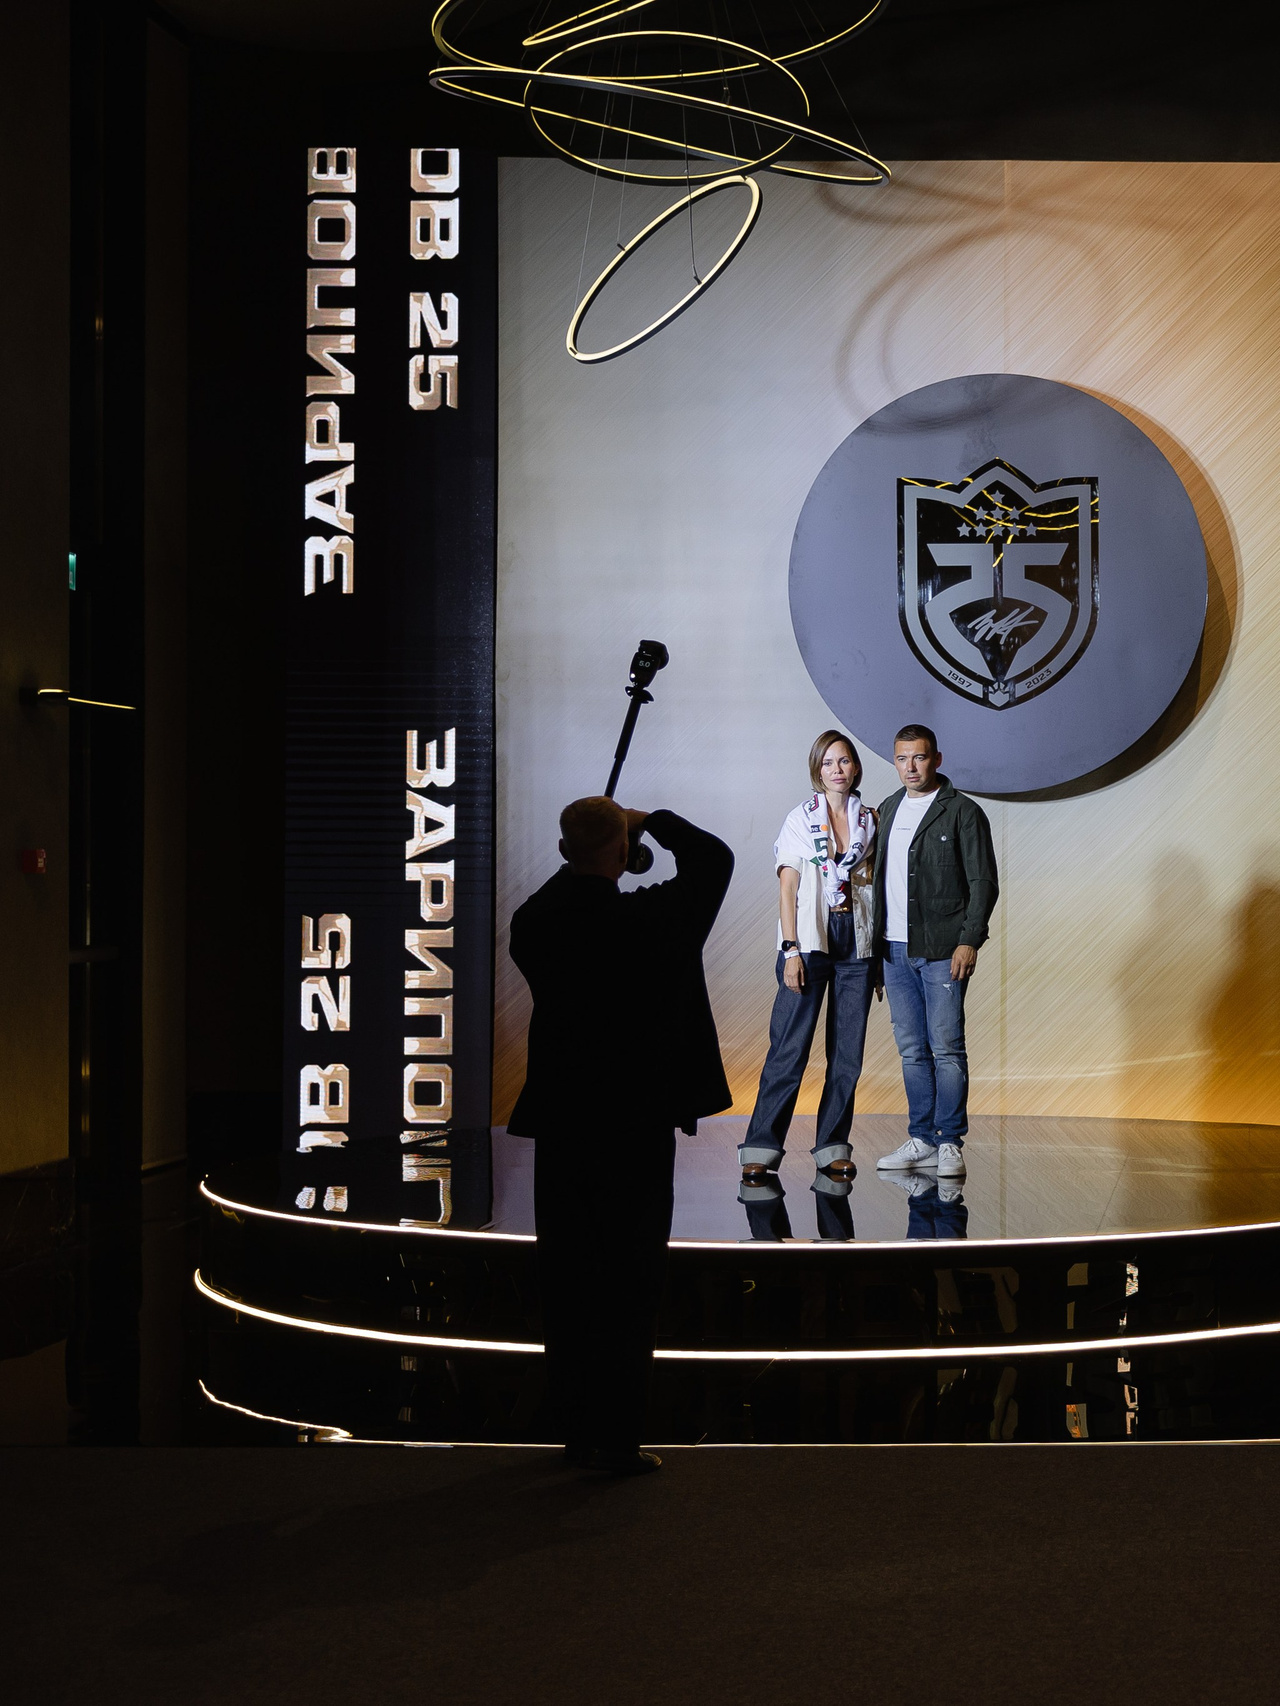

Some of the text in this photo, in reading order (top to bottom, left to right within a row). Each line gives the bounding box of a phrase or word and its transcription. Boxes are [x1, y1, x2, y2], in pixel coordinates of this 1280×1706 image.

[304, 146, 357, 597] ЗАРИПОВ
[408, 291, 460, 411] 25
[947, 668, 1053, 689] 1997 2023
[300, 912, 352, 1032] 25
